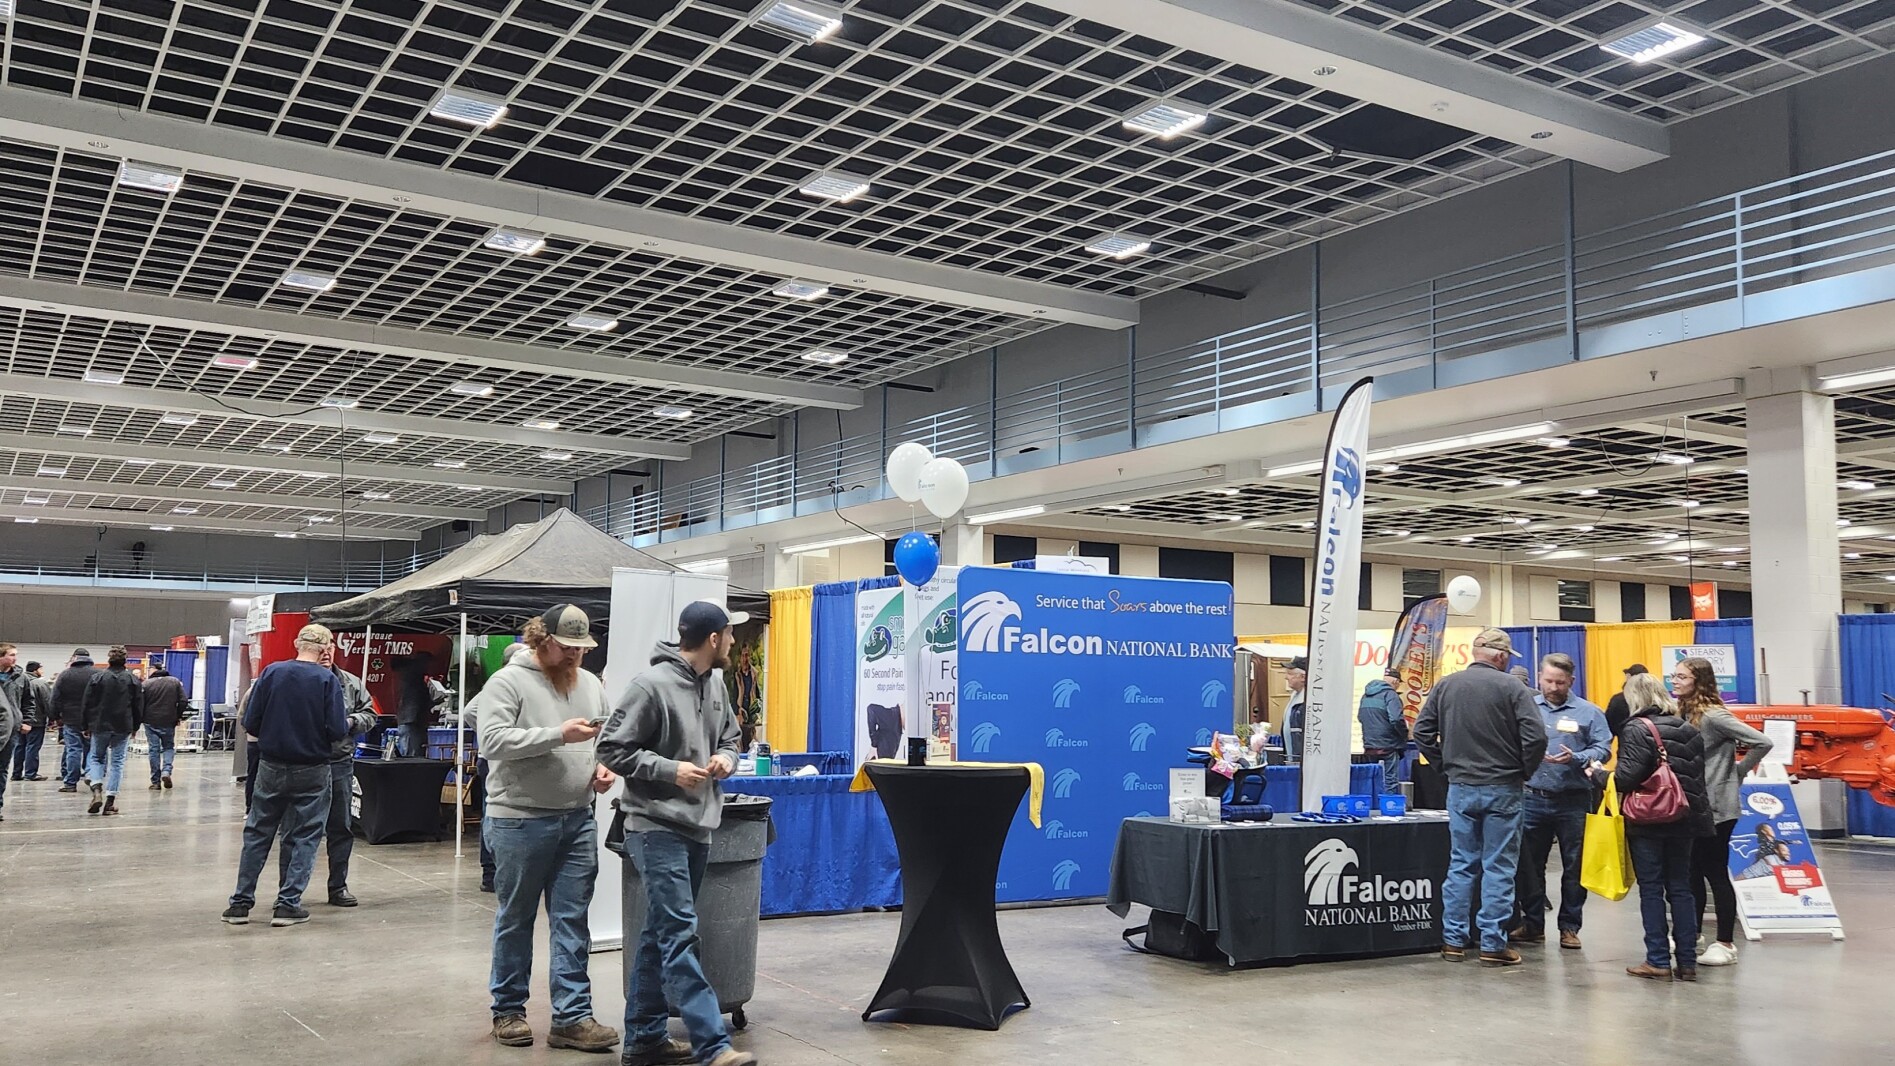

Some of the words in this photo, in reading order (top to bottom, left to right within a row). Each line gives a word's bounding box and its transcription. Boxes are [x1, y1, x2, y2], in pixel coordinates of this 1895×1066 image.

[1036, 594, 1079, 609] Service
[1081, 596, 1106, 610] that
[1149, 600, 1183, 614] above
[1185, 601, 1204, 615] the
[336, 632, 393, 650] Clovrdale
[1003, 627, 1103, 656] Falcon
[1106, 640, 1187, 657] NATIONAL
[1189, 642, 1232, 659] BANK
[343, 640, 382, 658] Vertcal
[384, 641, 415, 656] TMRS
[1689, 648, 1725, 656] STEARNS
[367, 673, 380, 683] 420
[863, 668, 871, 679] 60
[871, 667, 891, 679] Second
[891, 667, 904, 679] Pain
[925, 686, 956, 706] and
[976, 691, 1009, 701] Falcon
[1135, 694, 1164, 704] Falcon
[1312, 702, 1324, 755] BANK
[1057, 738, 1089, 747] Falcon
[1134, 782, 1164, 790] Falcon
[1057, 829, 1089, 839] Falcon
[1342, 874, 1433, 904] Falcon
[1304, 906, 1387, 926] NATIONAL
[1388, 903, 1433, 922] BANK
[1416, 920, 1433, 930] FDIC
